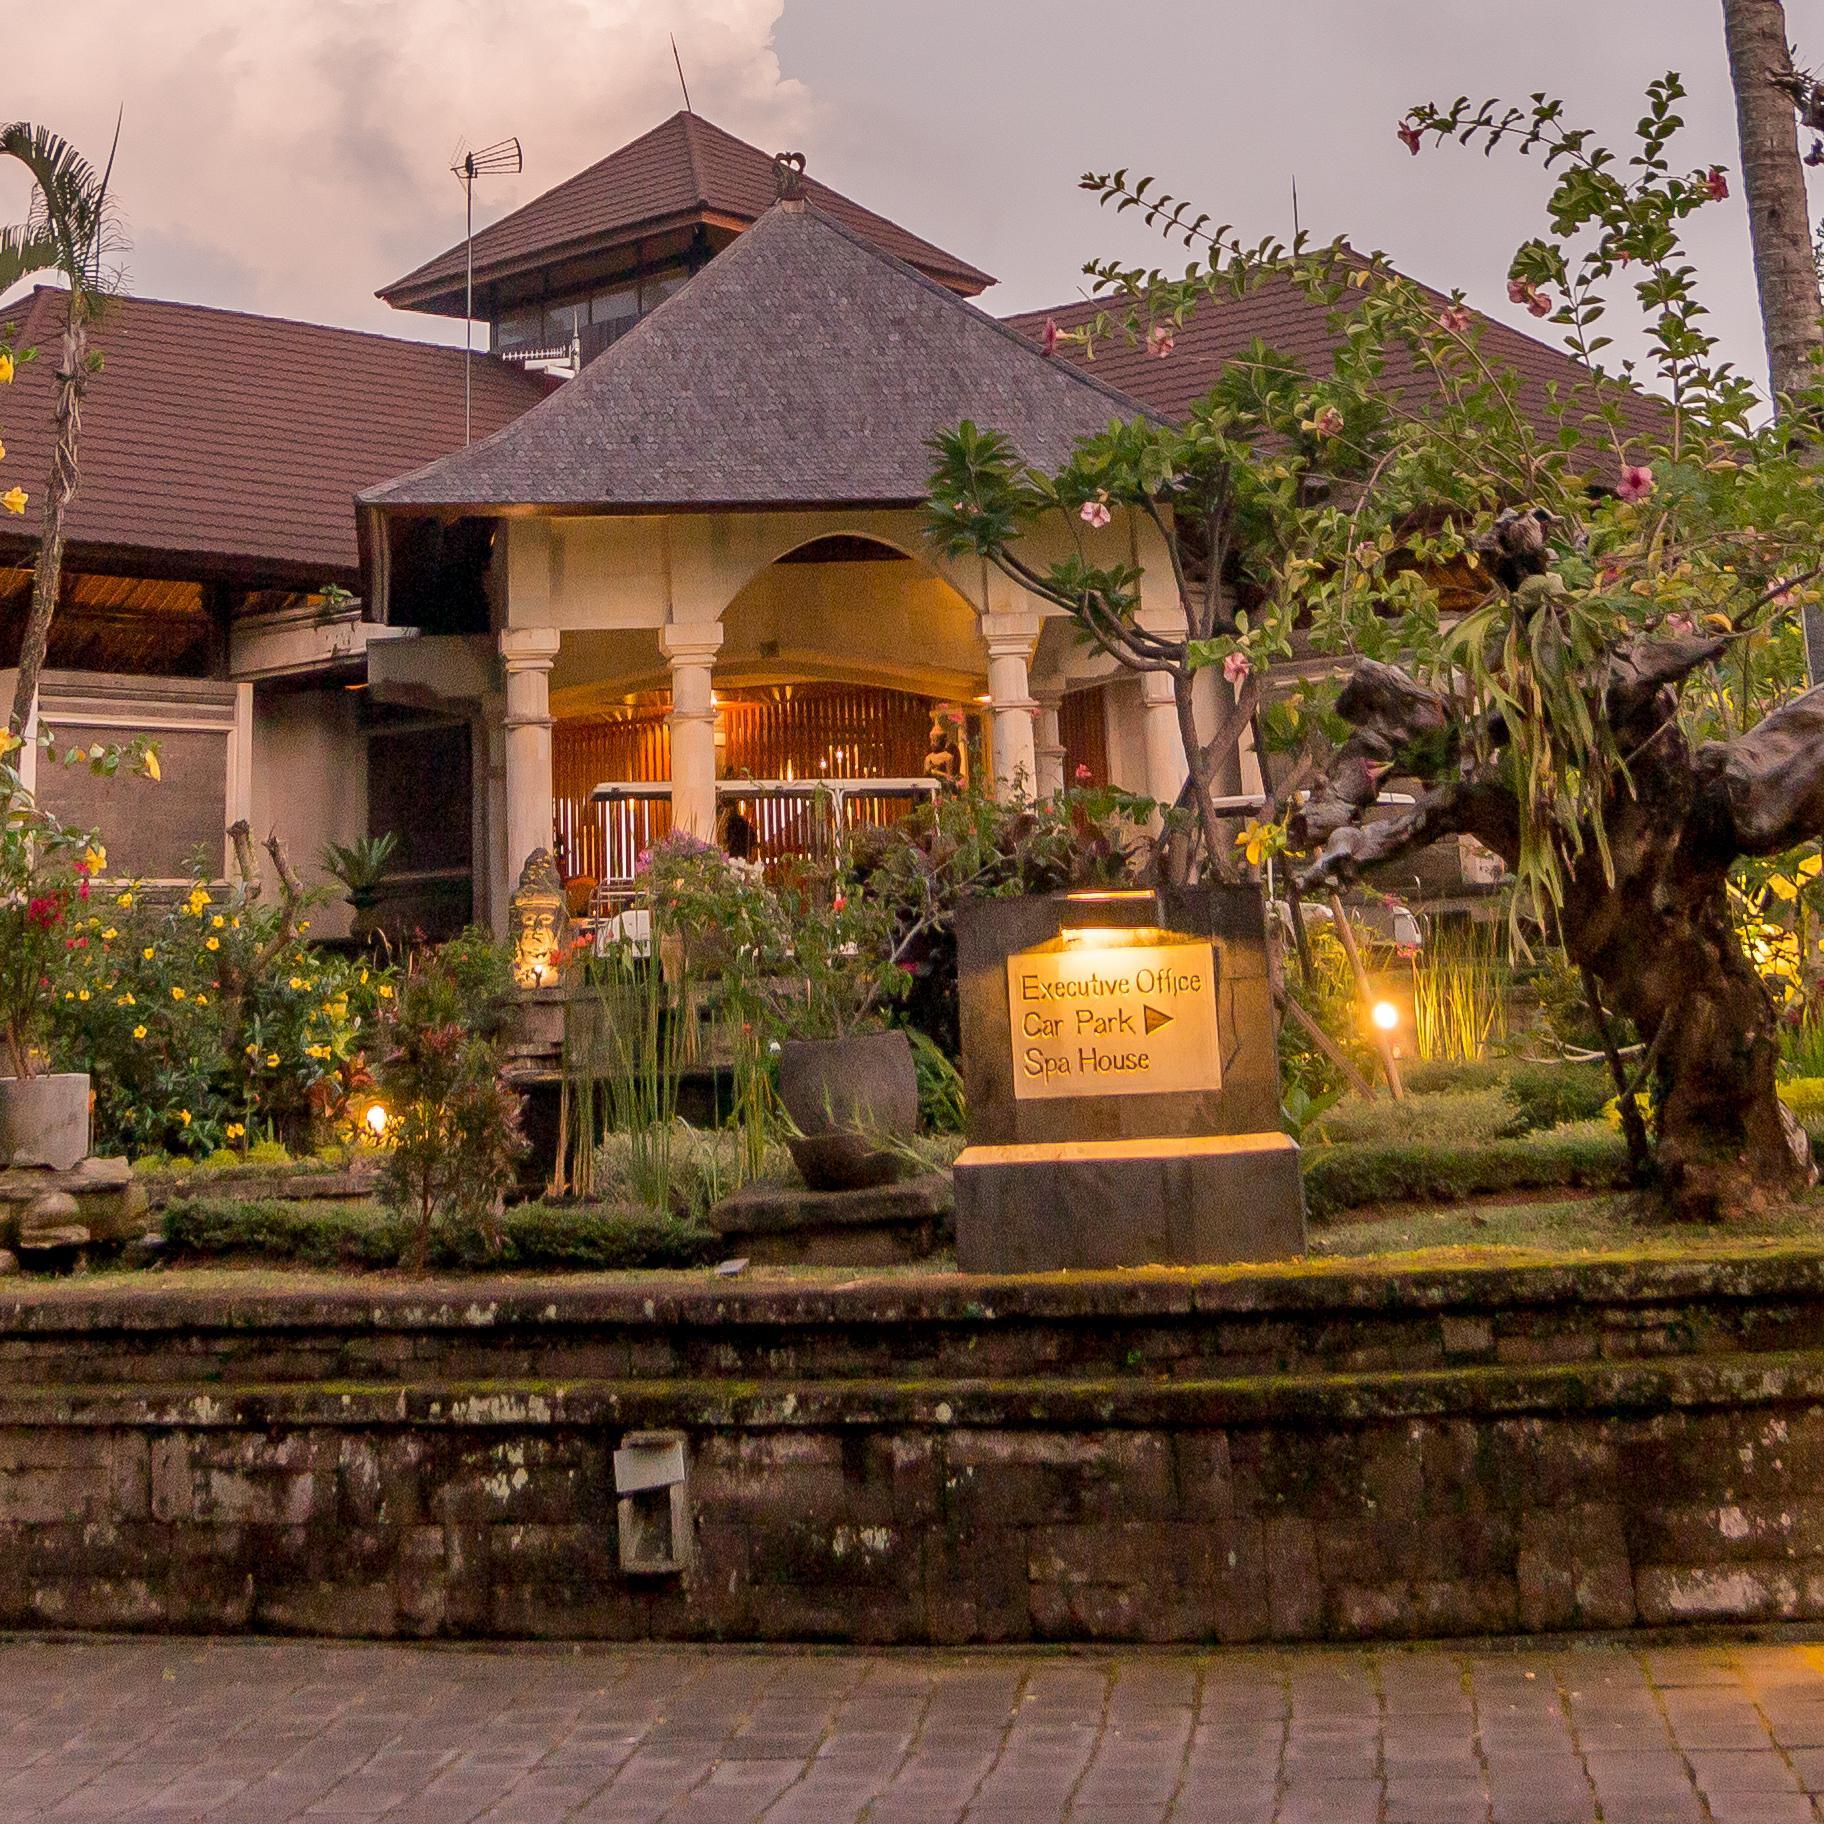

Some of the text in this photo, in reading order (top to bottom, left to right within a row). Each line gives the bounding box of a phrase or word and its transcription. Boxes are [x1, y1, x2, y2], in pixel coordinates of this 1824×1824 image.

[1022, 968, 1201, 1001] Executive Office
[1023, 1008, 1136, 1038] Car Park
[1024, 1047, 1150, 1086] Spa House
